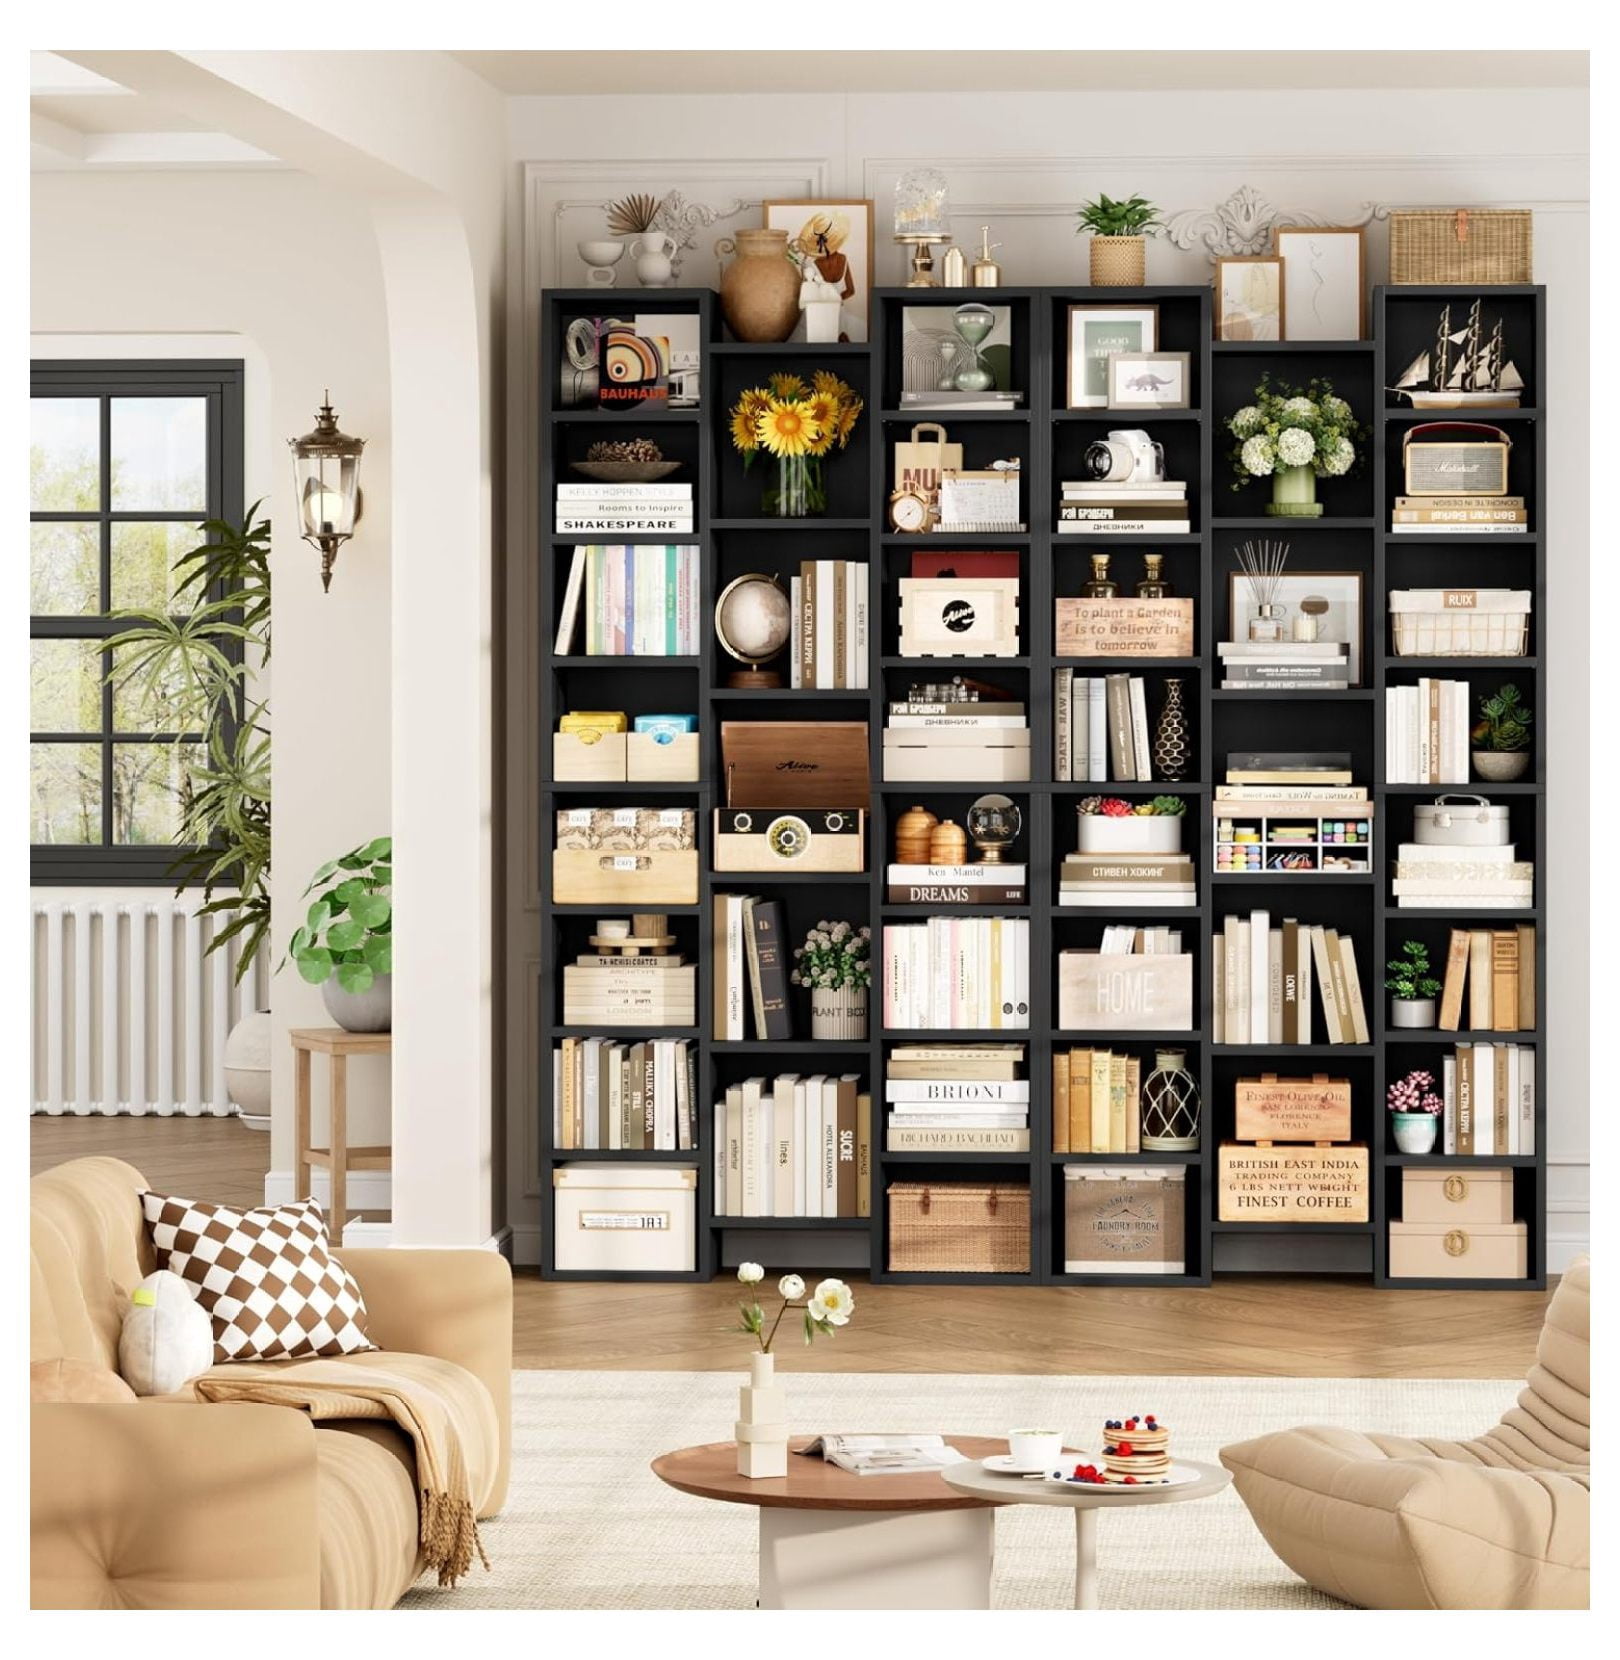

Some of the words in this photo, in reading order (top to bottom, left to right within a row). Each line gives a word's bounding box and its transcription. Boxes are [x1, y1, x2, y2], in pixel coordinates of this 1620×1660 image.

[600, 388, 667, 399] BAUHAUS
[599, 504, 633, 512] Rooms
[649, 504, 684, 514] Inspire
[1470, 511, 1491, 519] van
[1494, 511, 1516, 521] Ben
[564, 520, 677, 529] SHAKESPEARE
[1448, 595, 1473, 606] RUIX
[804, 603, 812, 635] СЕСТРА
[1075, 607, 1088, 618] To
[1092, 607, 1124, 619] plant
[1137, 607, 1181, 618] Garden
[1091, 624, 1105, 634] to
[1110, 623, 1160, 634] believe
[804, 636, 812, 664] КЕРРИ
[1095, 640, 1158, 650] tomorrow
[928, 867, 946, 877] Ken
[1093, 866, 1128, 877] СТИВЕН
[1130, 867, 1165, 877] ХОКИНГ
[910, 887, 969, 901] DREAMS
[1006, 891, 1021, 899] LIFE
[1097, 972, 1154, 1013] HOME
[1286, 974, 1295, 1002] LOEWE
[645, 1060, 653, 1096] MALLIKA
[928, 1085, 1002, 1099] BRIONI
[632, 1091, 641, 1110] STILL
[645, 1099, 653, 1133] CHOPRA
[840, 1130, 853, 1161] SUCRE
[1229, 1160, 1278, 1169] BRITISH
[1284, 1160, 1316, 1169] EAST
[1322, 1160, 1359, 1169] INDIA
[1237, 1196, 1288, 1208] FINEST
[1296, 1196, 1353, 1208] COFFEE
